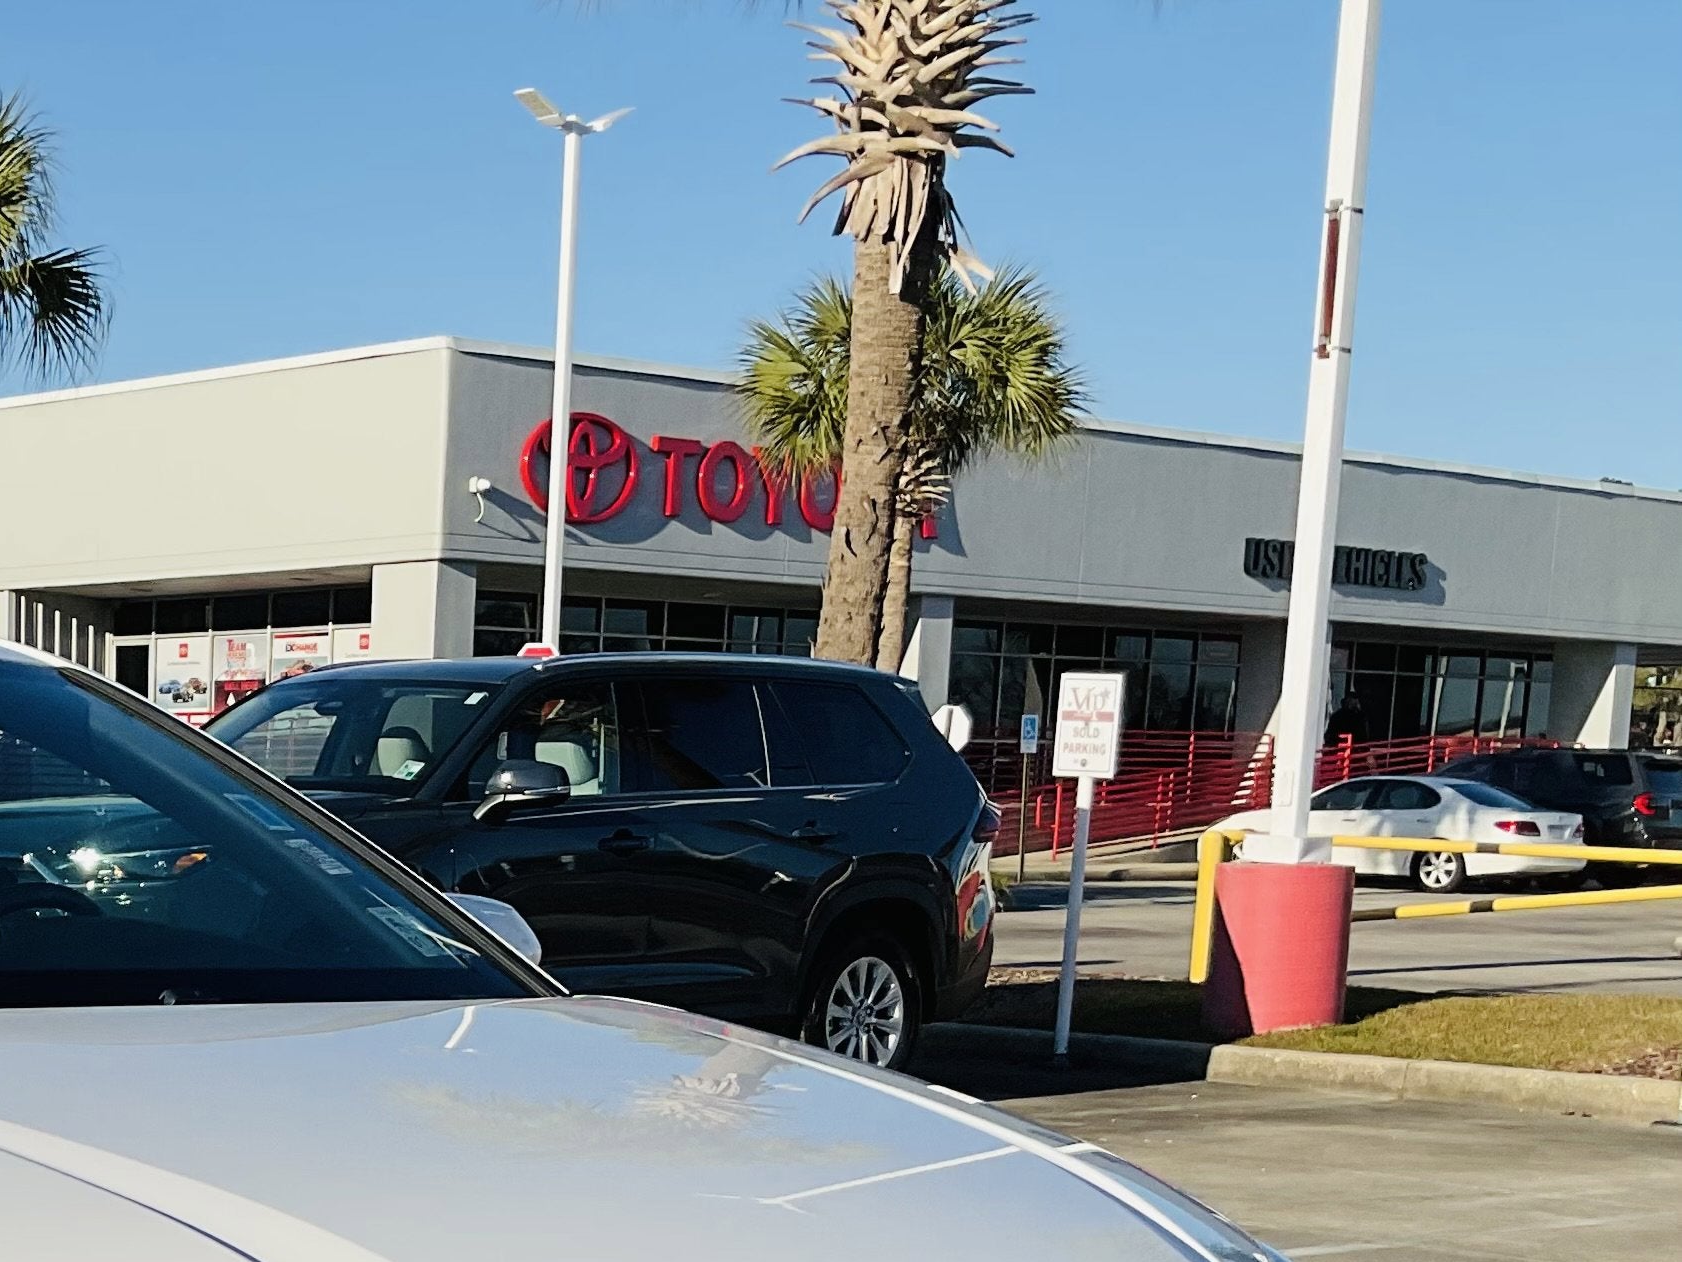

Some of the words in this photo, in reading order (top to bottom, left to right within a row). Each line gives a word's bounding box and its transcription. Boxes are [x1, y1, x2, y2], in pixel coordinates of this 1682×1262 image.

[651, 434, 938, 539] TOYO
[1332, 546, 1429, 591] EHICLES
[1072, 727, 1100, 739] SOLD
[1063, 742, 1106, 756] PARKING
